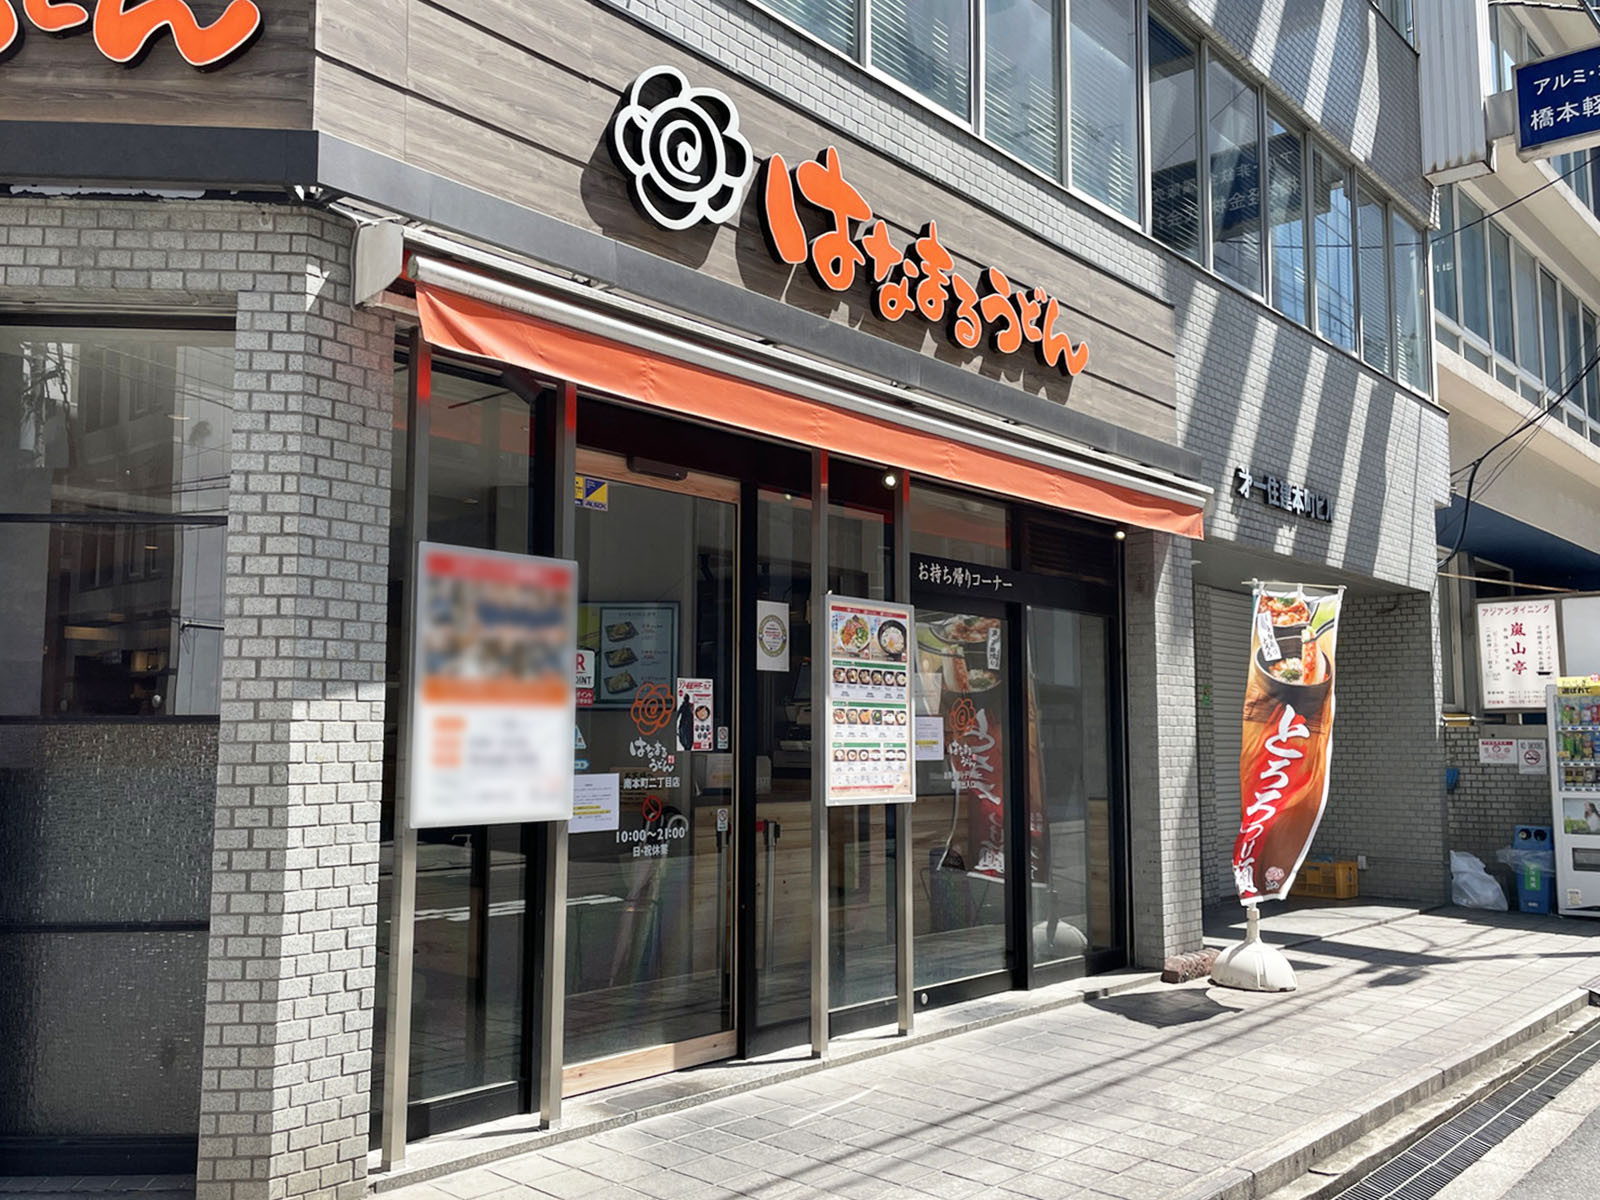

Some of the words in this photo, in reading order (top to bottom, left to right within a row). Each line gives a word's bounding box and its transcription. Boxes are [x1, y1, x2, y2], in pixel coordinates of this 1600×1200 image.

[1533, 65, 1600, 95] アルミ・
[763, 145, 1089, 376] はなまるうどん
[918, 561, 1013, 592] お持ち帰りコーナー
[1482, 604, 1550, 617] アジアンダイニング
[1510, 621, 1528, 676] 嵐山亭
[630, 736, 668, 758] はなまる
[648, 758, 675, 773] うどん
